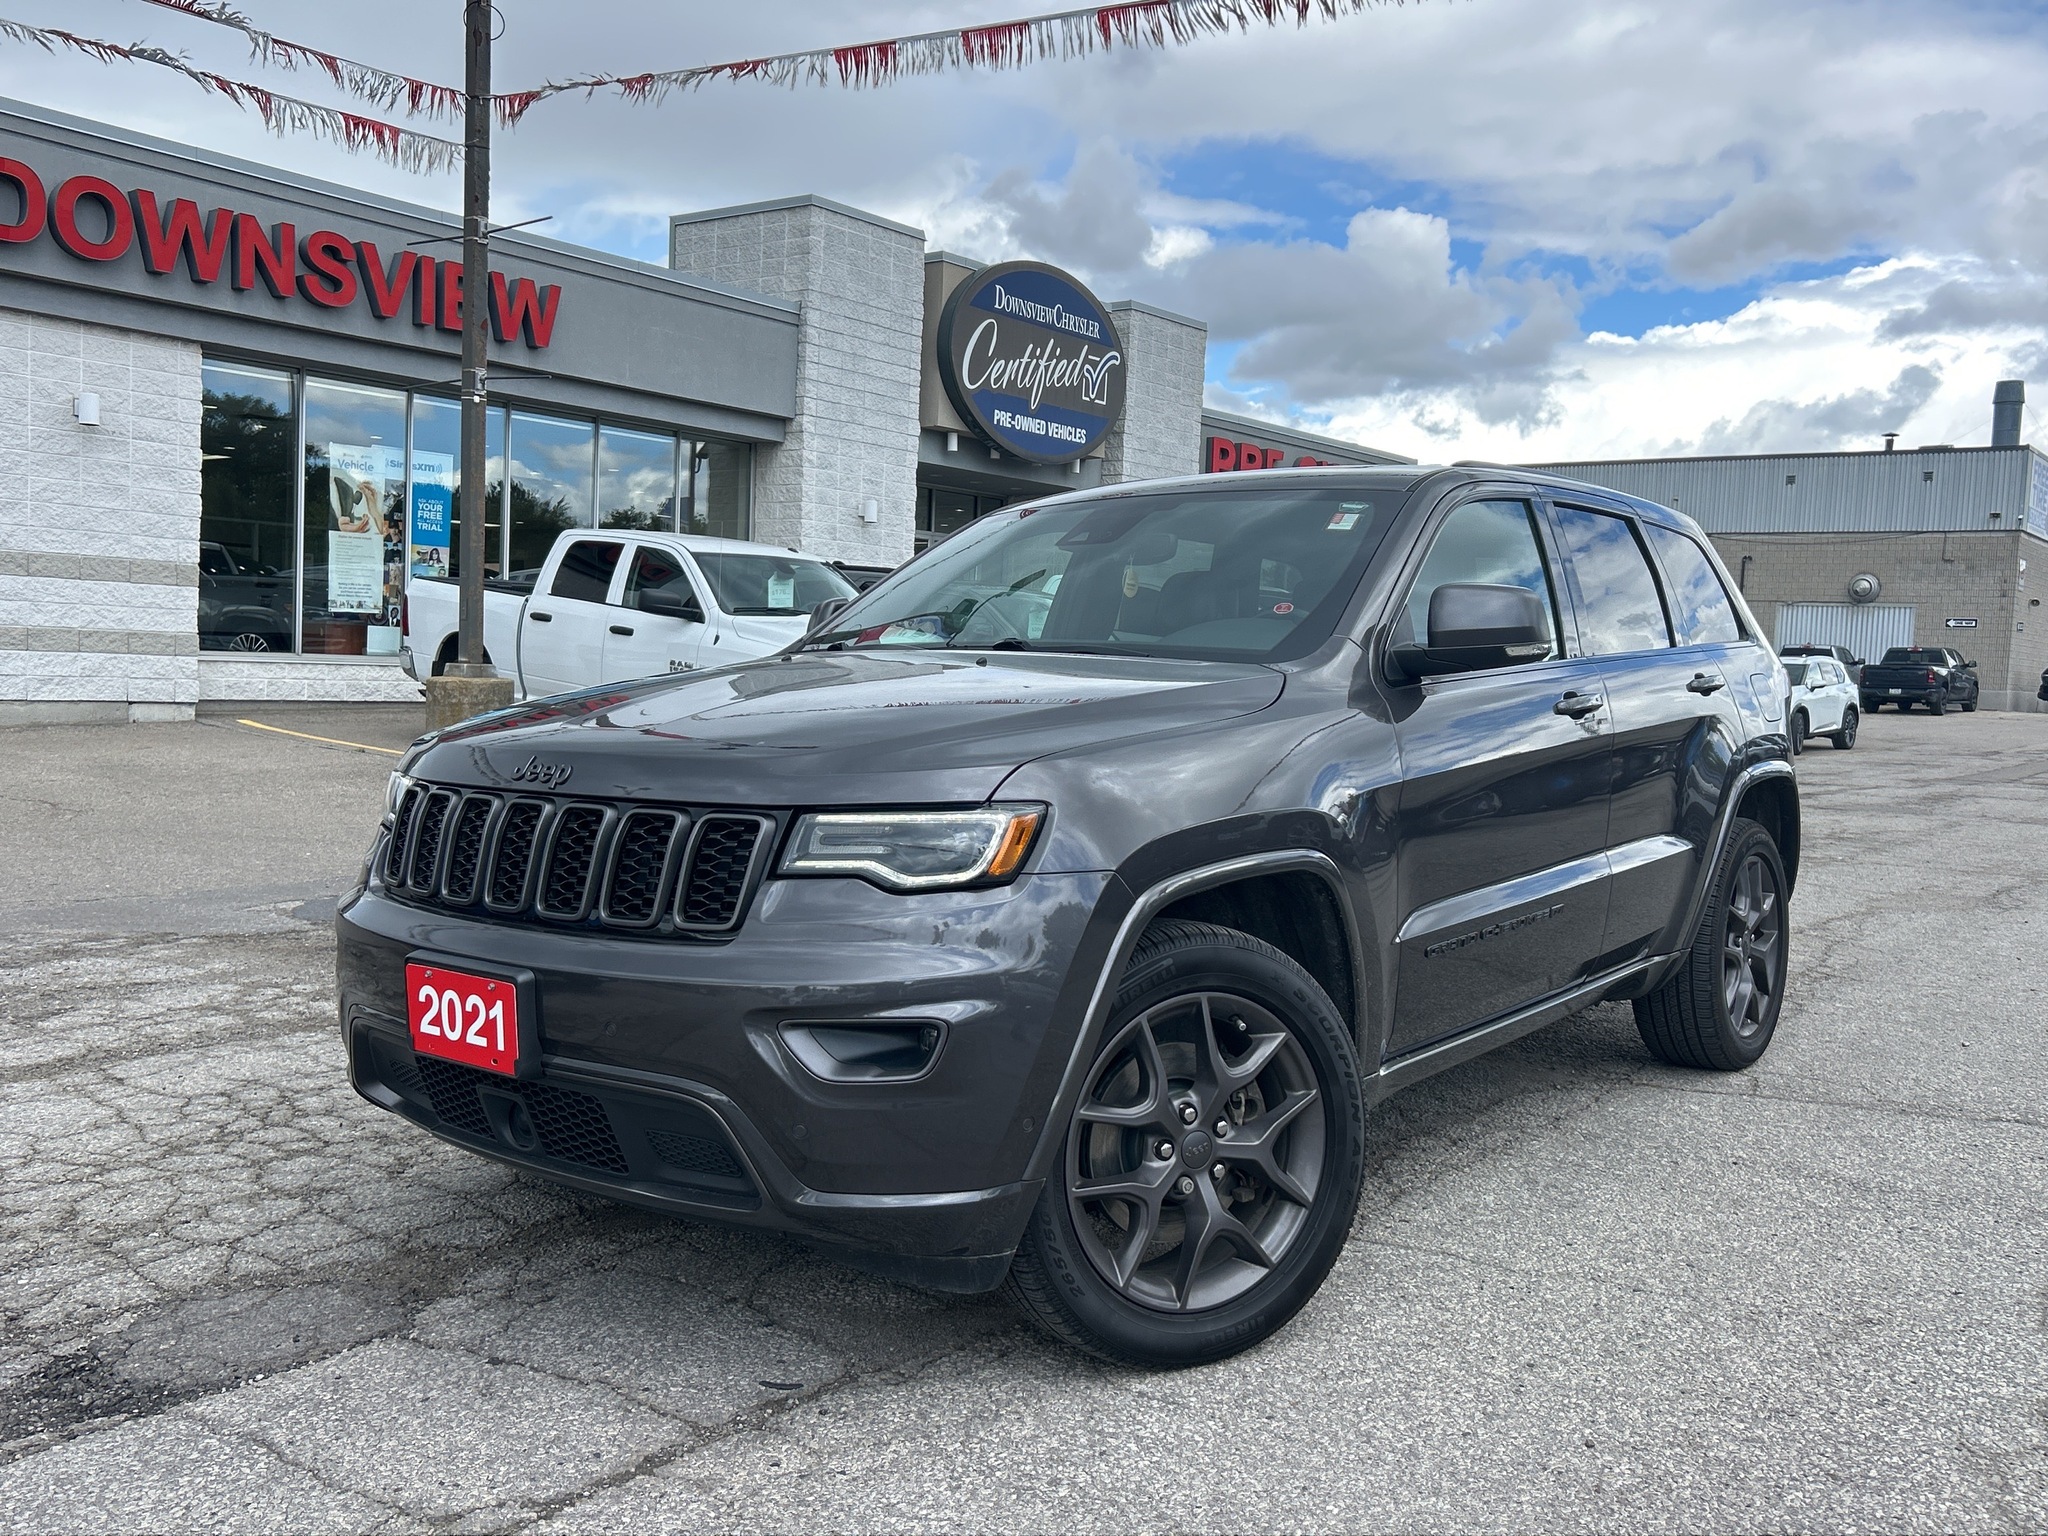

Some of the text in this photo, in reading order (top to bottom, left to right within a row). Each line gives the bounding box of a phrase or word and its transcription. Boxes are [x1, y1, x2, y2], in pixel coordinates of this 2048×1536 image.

[962, 318, 1089, 410] Certified
[993, 409, 1087, 444] PRE-OWNED VEHICLES
[337, 458, 374, 473] Vehicle
[418, 502, 443, 512] YOUR
[418, 510, 443, 520] FREE
[417, 522, 443, 532] TRIAL
[511, 755, 574, 790] Jeep
[418, 984, 505, 1052] 2021
